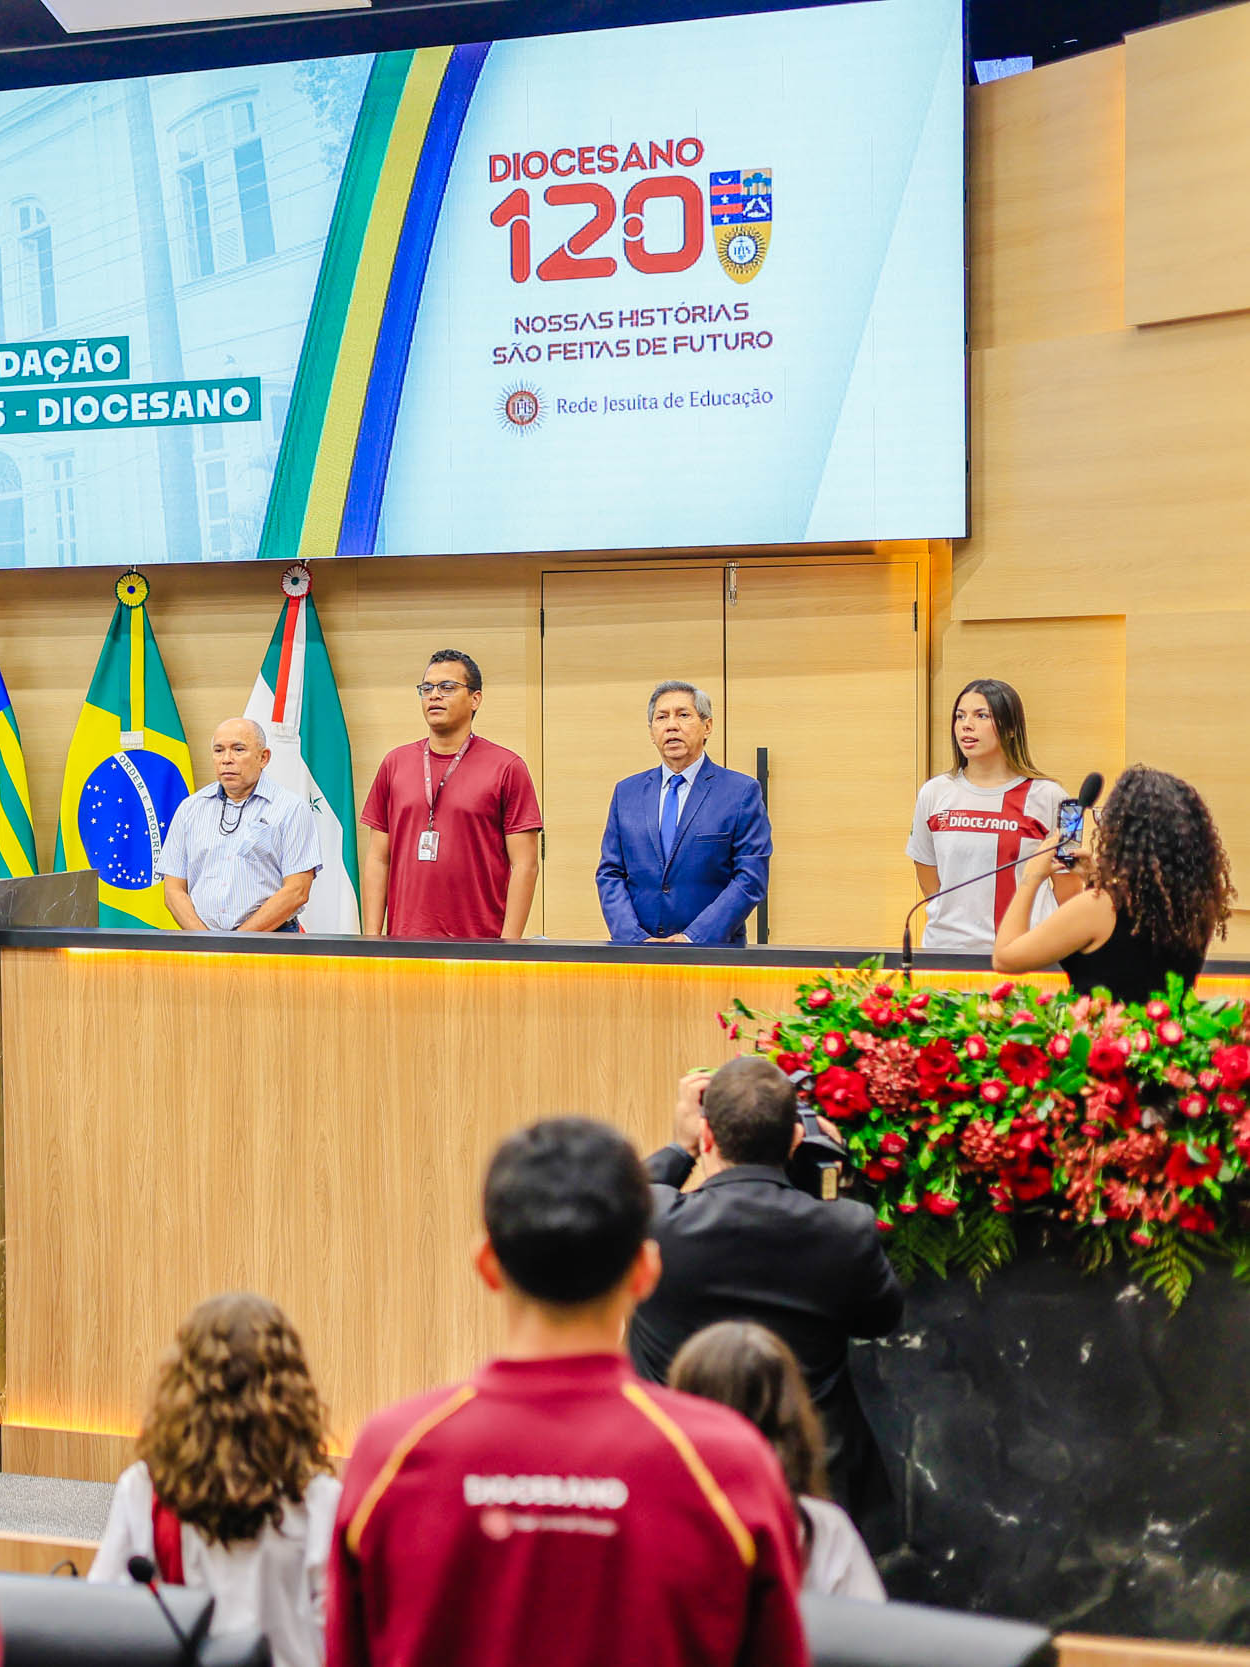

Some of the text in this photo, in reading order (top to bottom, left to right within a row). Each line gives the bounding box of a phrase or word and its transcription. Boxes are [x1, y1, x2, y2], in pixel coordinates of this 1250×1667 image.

[489, 137, 704, 183] DIOCESANO
[490, 175, 704, 283] 120
[514, 302, 749, 334] NOSSAS HISTÓRIAS
[493, 331, 773, 365] SÃO FEITAS DE FUTURO
[38, 386, 250, 426] DIOCESANO
[557, 398, 598, 414] Rede
[665, 393, 684, 408] de
[690, 388, 773, 409] Educação
[119, 755, 144, 790] ORDEM
[147, 808, 161, 880] PROGRESO
[950, 817, 1018, 831] DIOCESANO
